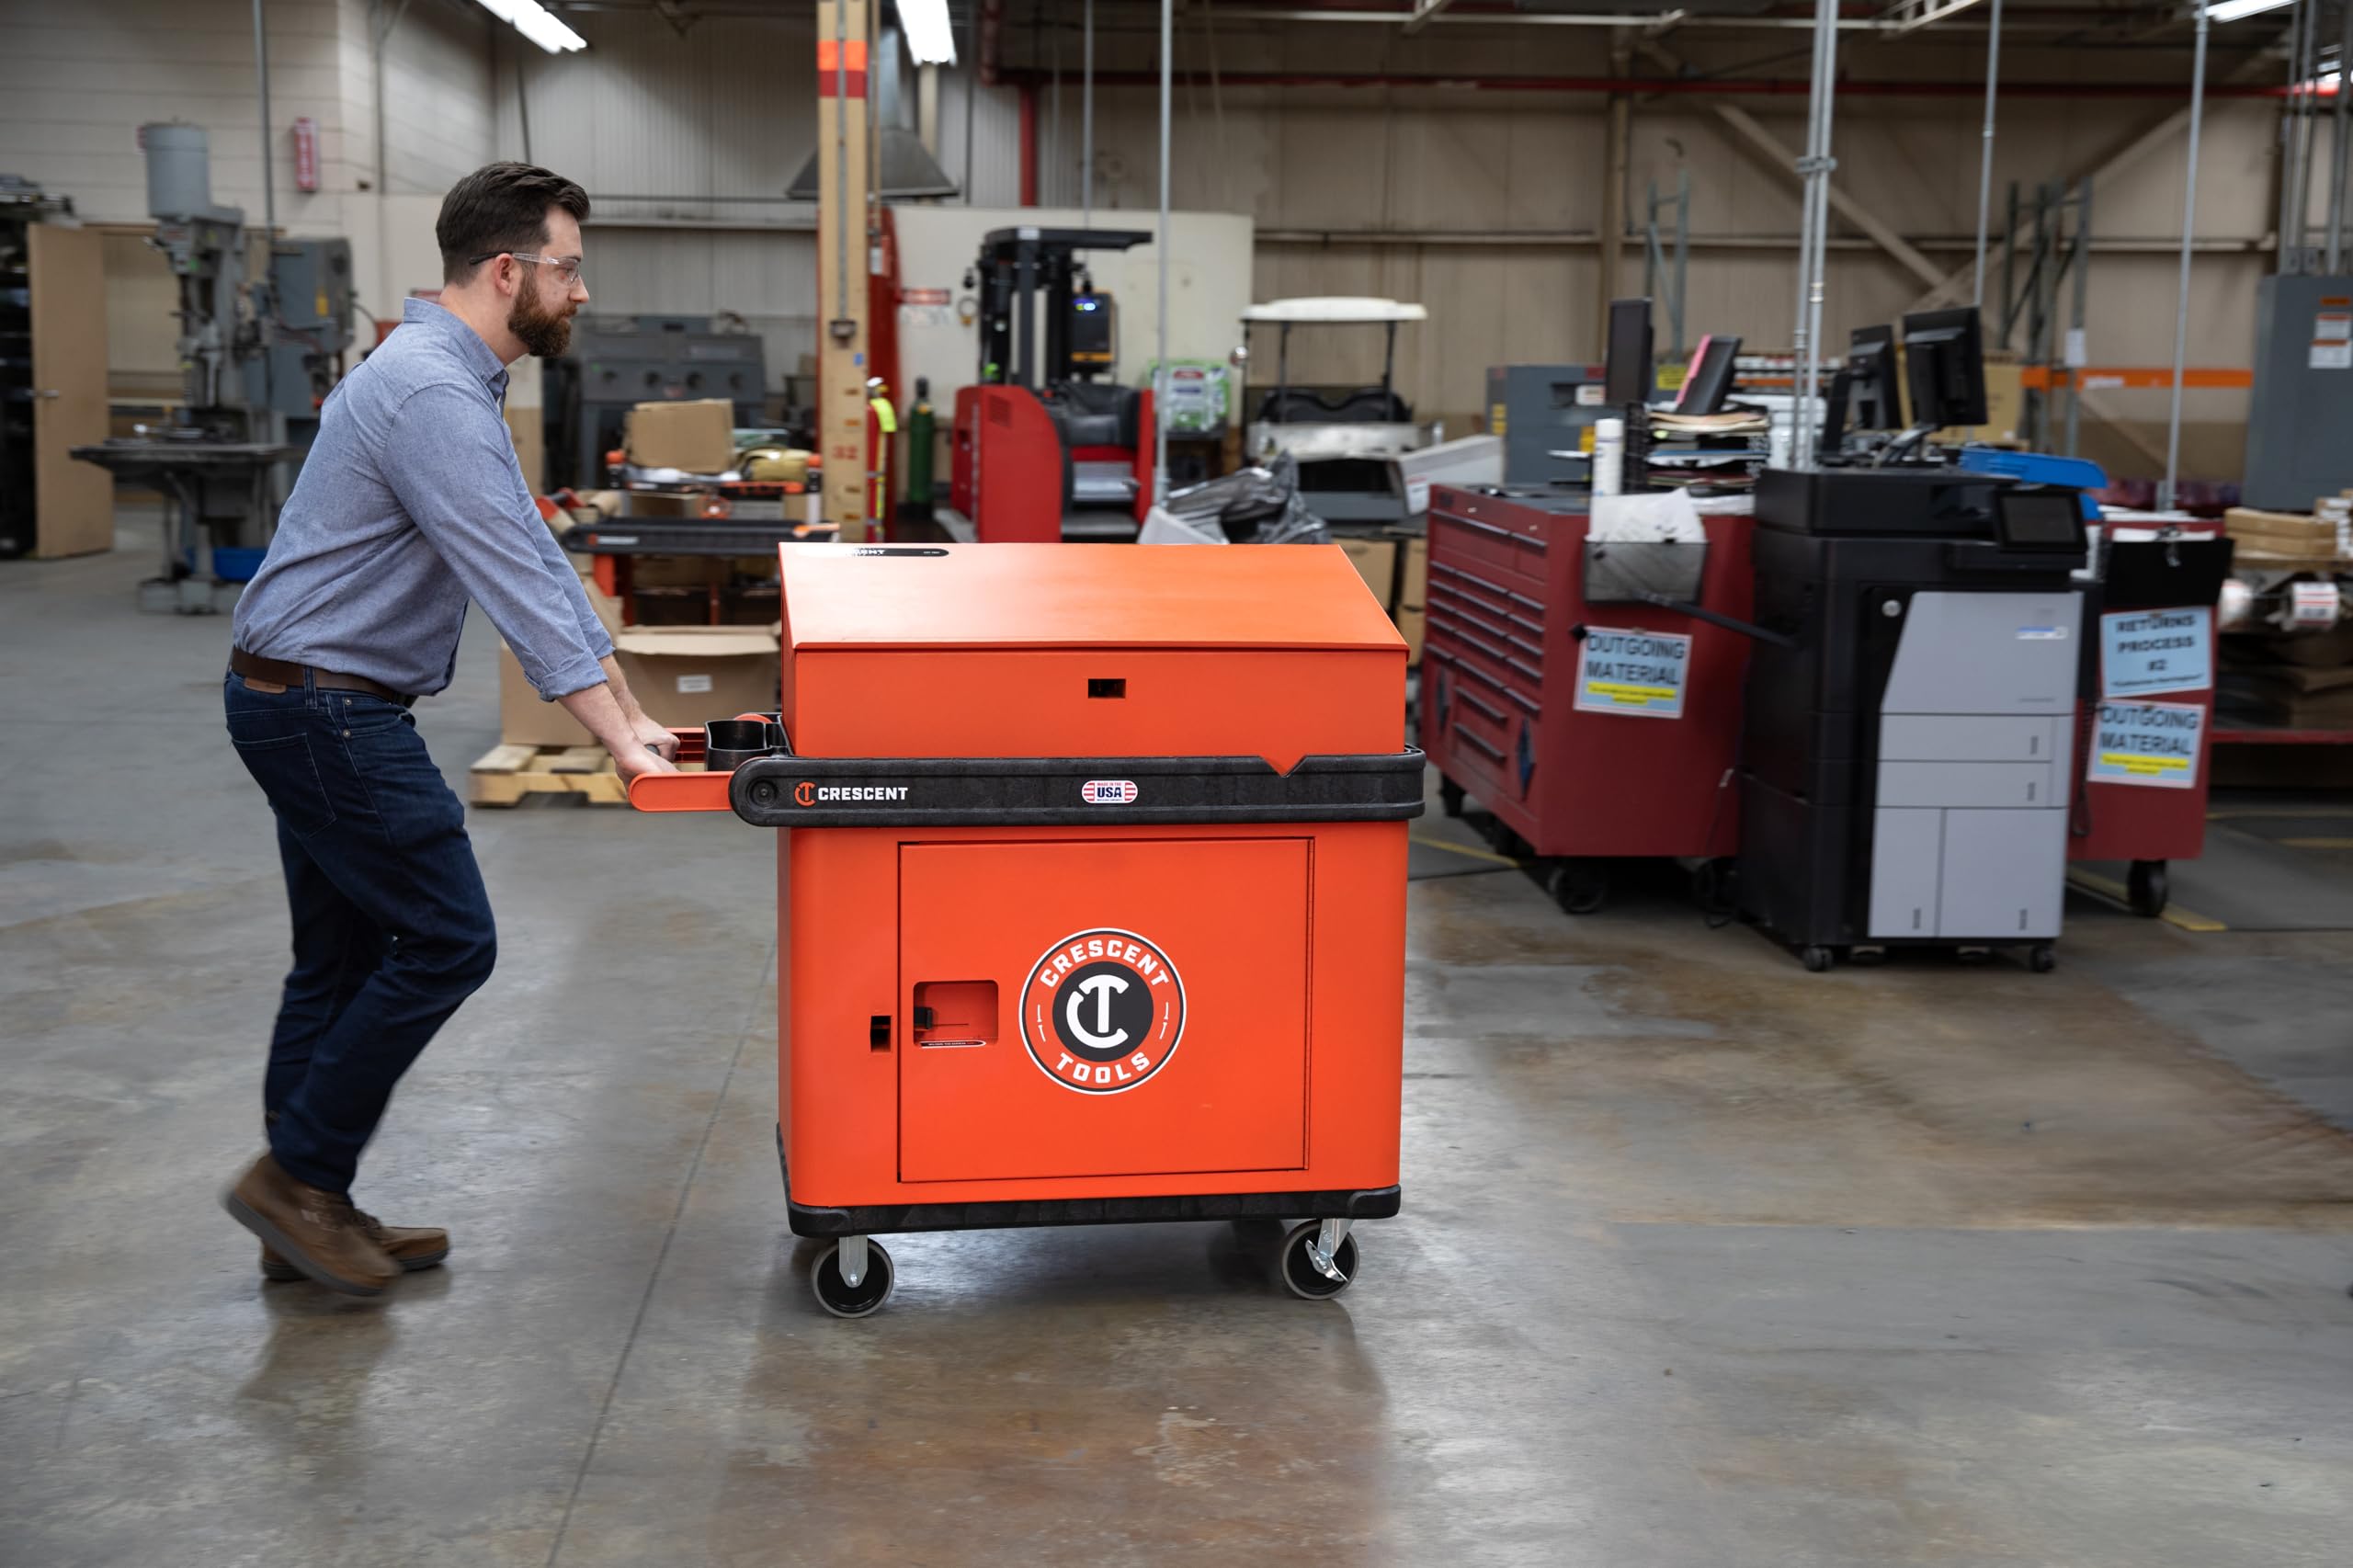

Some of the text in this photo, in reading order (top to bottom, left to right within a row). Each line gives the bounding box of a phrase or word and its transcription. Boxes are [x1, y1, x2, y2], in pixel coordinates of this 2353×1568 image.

[2116, 614, 2196, 632] RETURNS
[1587, 634, 1686, 659] OUTGOING
[2117, 636, 2195, 653] PROCESS
[1587, 660, 1679, 685] MATERIAL
[2100, 705, 2199, 730] OUTGOING
[2099, 733, 2191, 756] MATERIAL
[817, 787, 908, 801] CRESCENT
[1097, 787, 1122, 798] USA
[1040, 939, 1169, 988] CRESCENT
[1056, 1051, 1150, 1084] TOOLS
